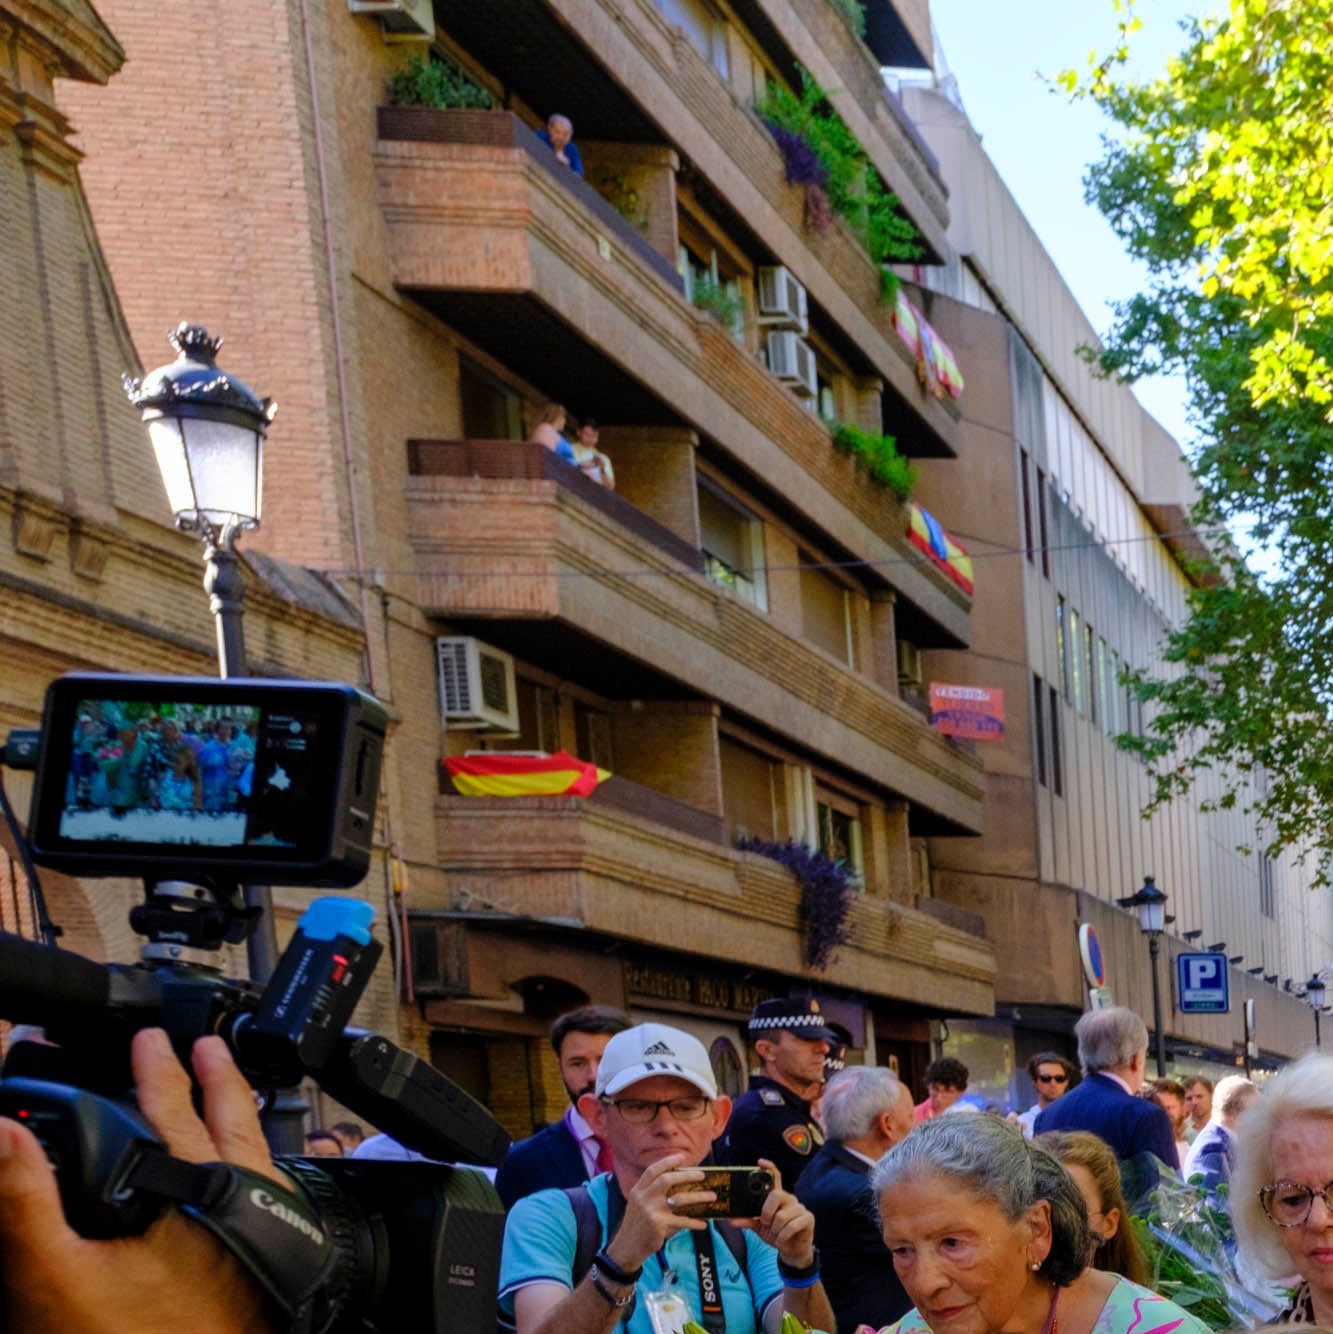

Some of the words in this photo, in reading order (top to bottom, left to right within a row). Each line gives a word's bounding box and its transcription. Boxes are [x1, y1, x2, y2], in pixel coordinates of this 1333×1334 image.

[1190, 960, 1217, 989] P
[250, 1187, 324, 1246] Canon
[450, 1264, 475, 1277] LEICA
[700, 1253, 716, 1303] SONY
